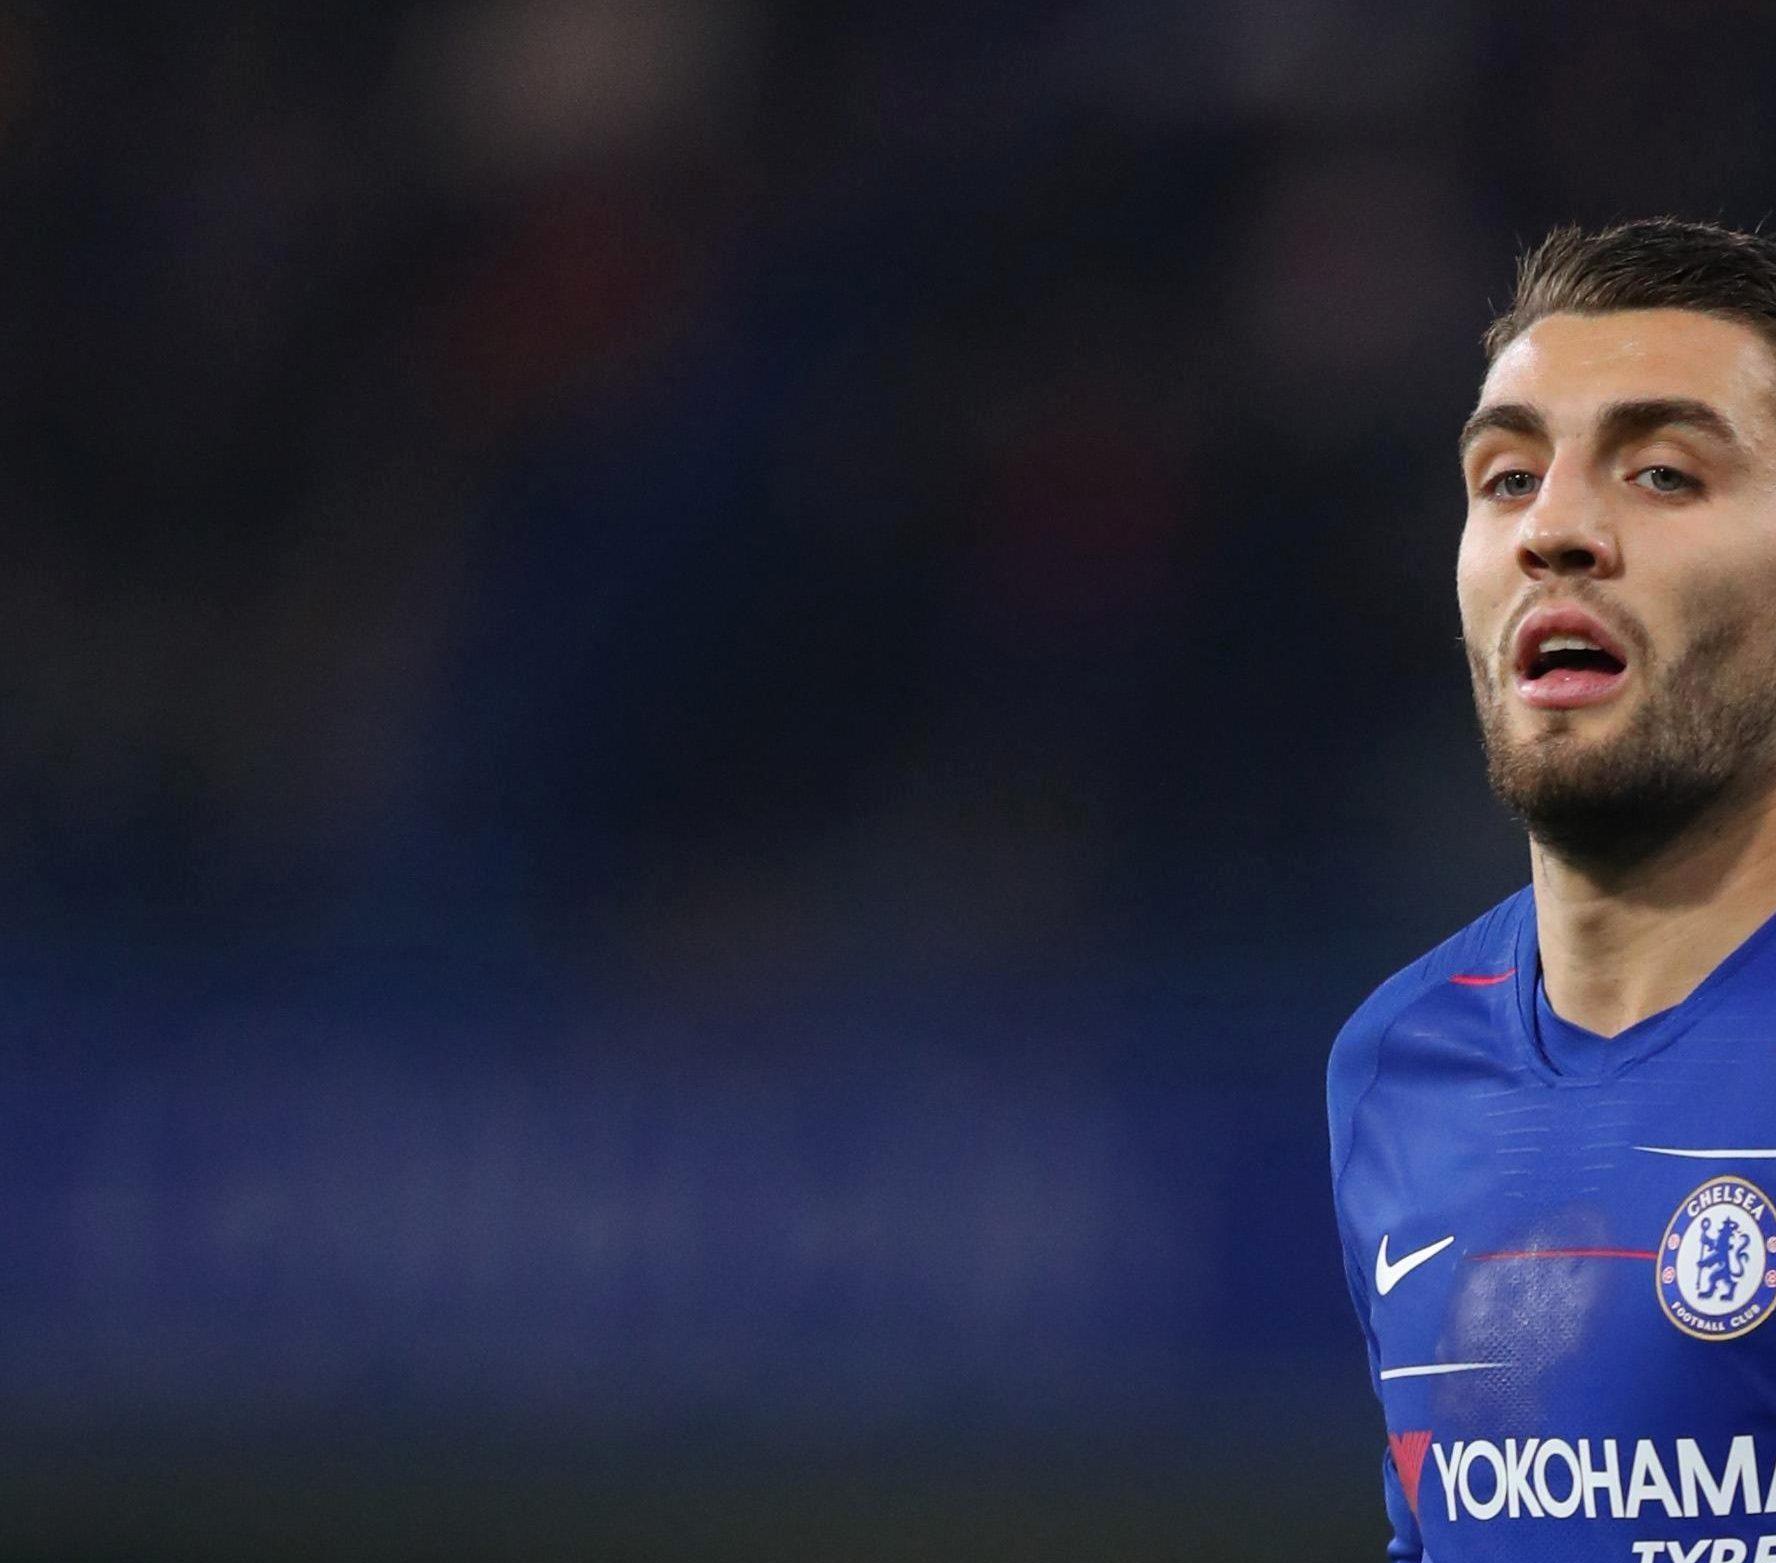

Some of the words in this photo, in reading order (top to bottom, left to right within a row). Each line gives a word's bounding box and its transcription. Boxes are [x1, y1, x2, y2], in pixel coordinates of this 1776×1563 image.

[1687, 1185, 1765, 1221] CHELSEA
[1671, 1301, 1725, 1331] FOOTBALL
[1730, 1304, 1761, 1327] CLUB
